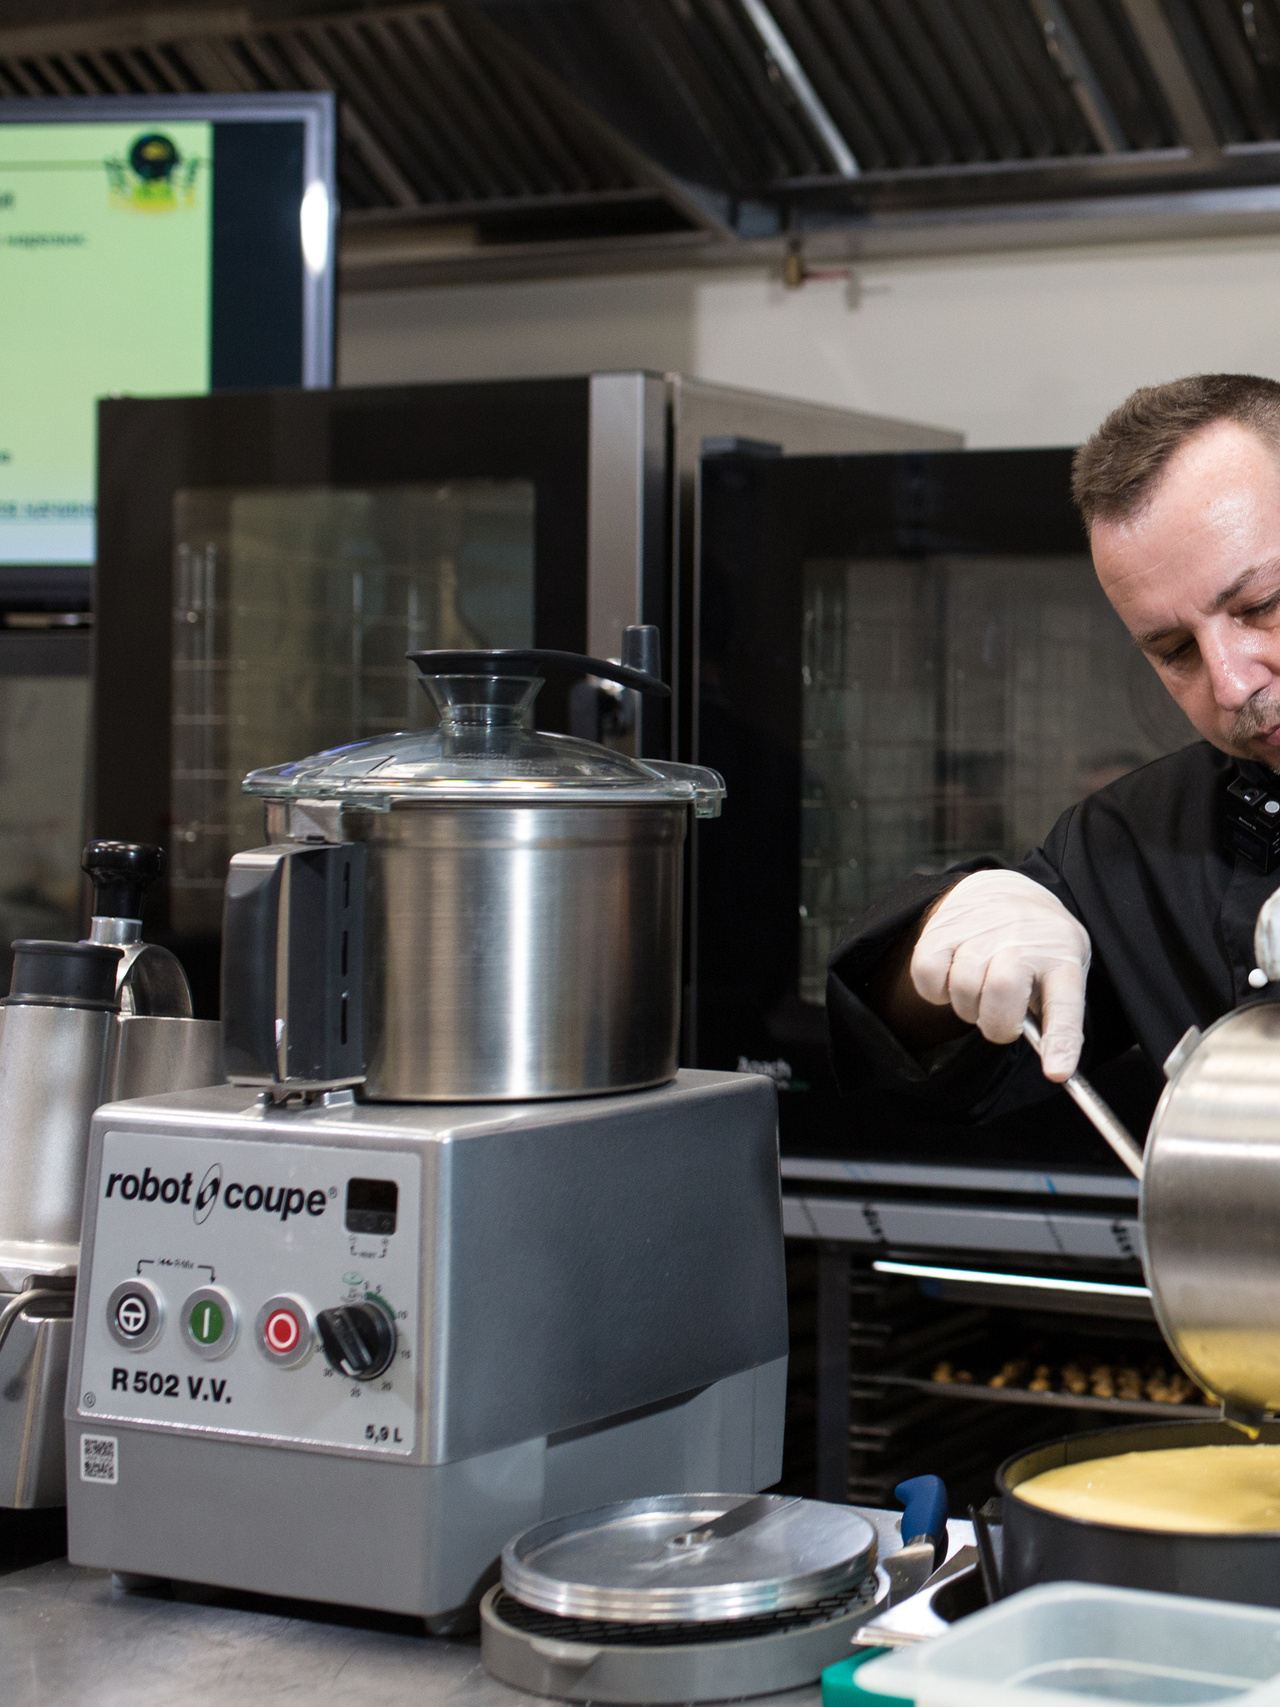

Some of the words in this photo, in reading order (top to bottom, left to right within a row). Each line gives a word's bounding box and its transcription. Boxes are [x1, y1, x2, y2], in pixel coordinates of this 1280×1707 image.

[105, 1168, 193, 1205] robot
[111, 1367, 129, 1392] R
[133, 1370, 180, 1398] 502
[187, 1376, 232, 1404] V.V.
[364, 1424, 390, 1444] 5,9
[393, 1427, 404, 1442] L
